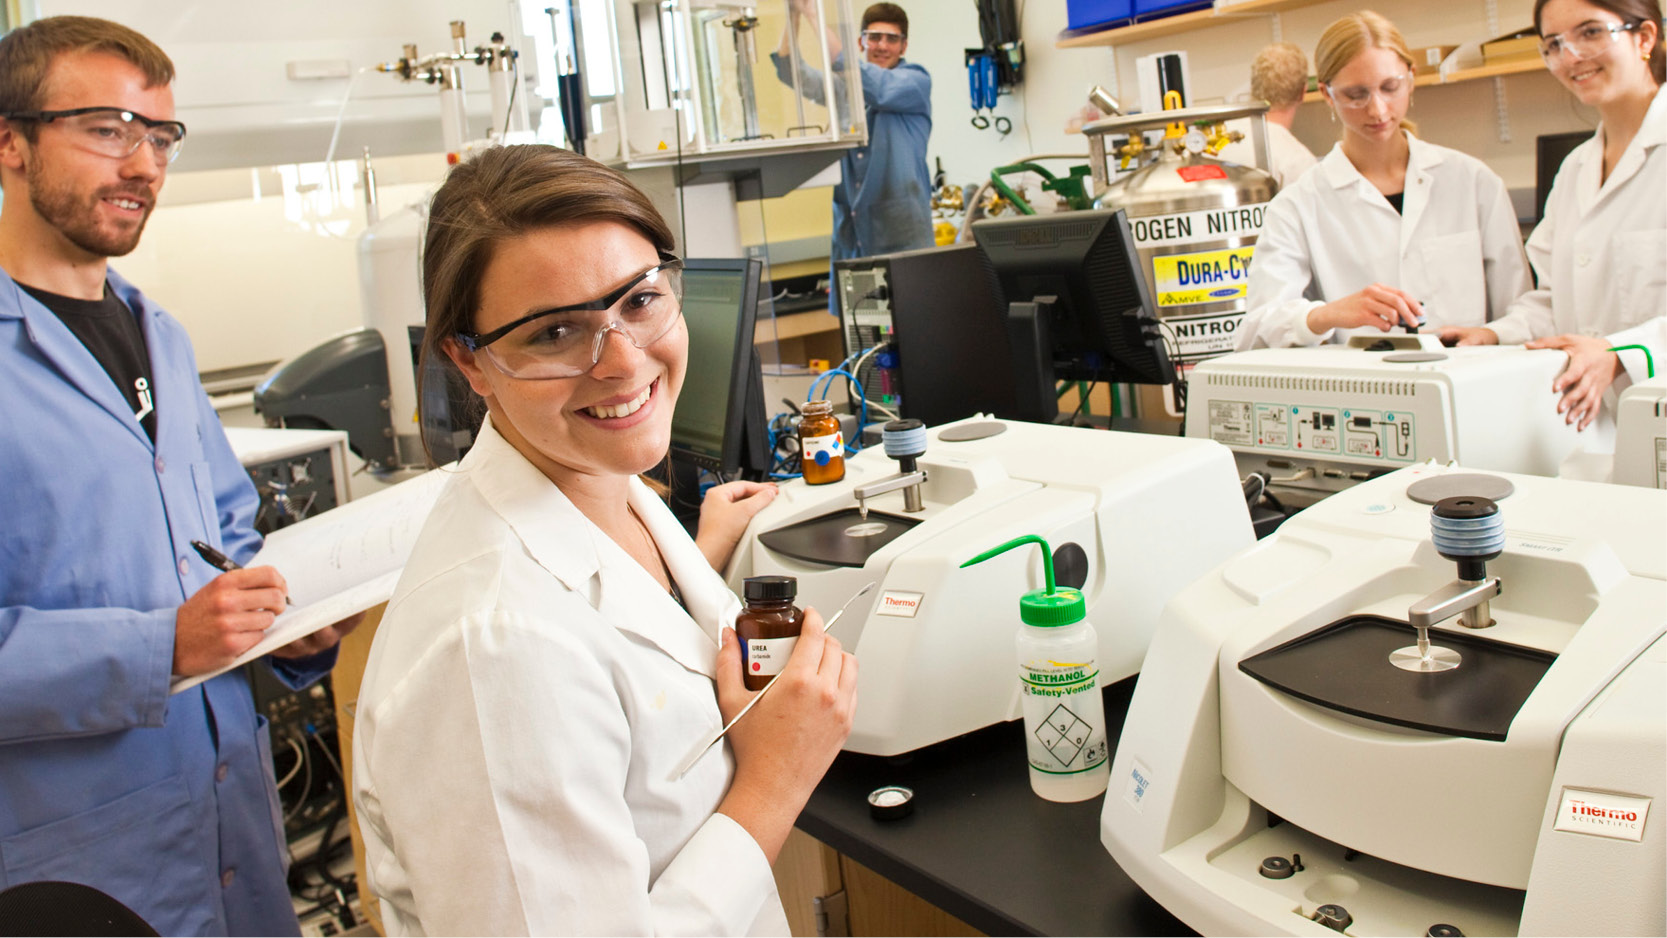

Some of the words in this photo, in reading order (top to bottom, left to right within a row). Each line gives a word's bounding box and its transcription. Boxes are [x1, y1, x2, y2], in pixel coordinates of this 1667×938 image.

[1128, 216, 1192, 242] OGEN
[1207, 206, 1267, 234] NITRO
[885, 596, 916, 607] Thermo
[1029, 670, 1086, 683] METHANOL
[1031, 679, 1096, 698] Safety-Vented
[1569, 799, 1638, 822] Thermo
[1571, 815, 1637, 830] SCIENTIFIC
